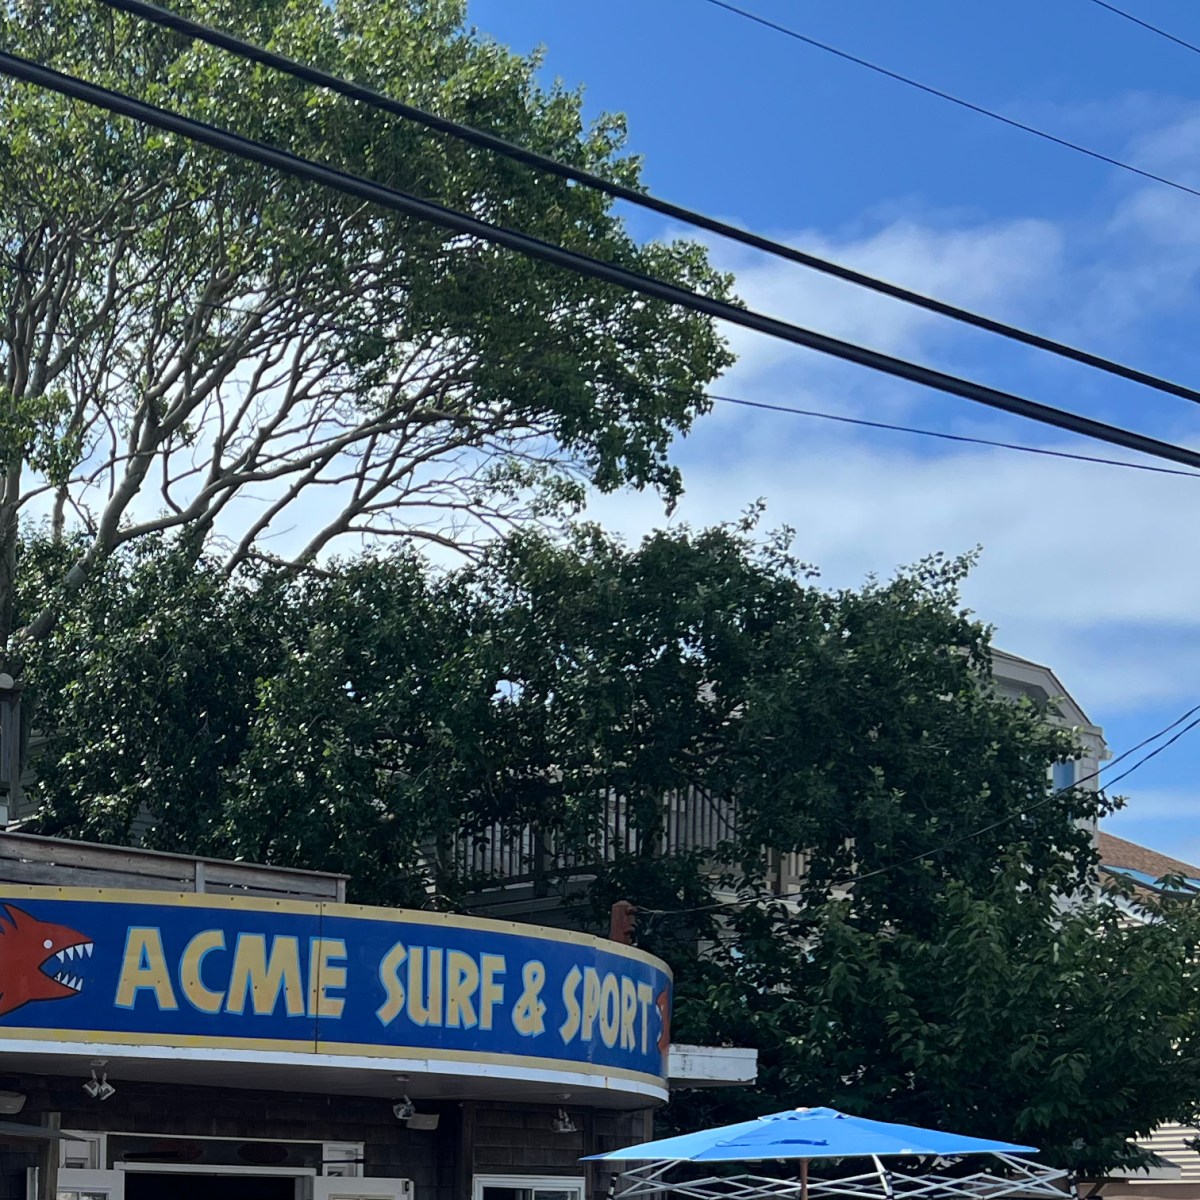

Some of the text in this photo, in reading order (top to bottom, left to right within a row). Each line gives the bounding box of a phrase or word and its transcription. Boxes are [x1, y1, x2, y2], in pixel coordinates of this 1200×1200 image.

[114, 926, 653, 1056] ACME SURF & SPORT
